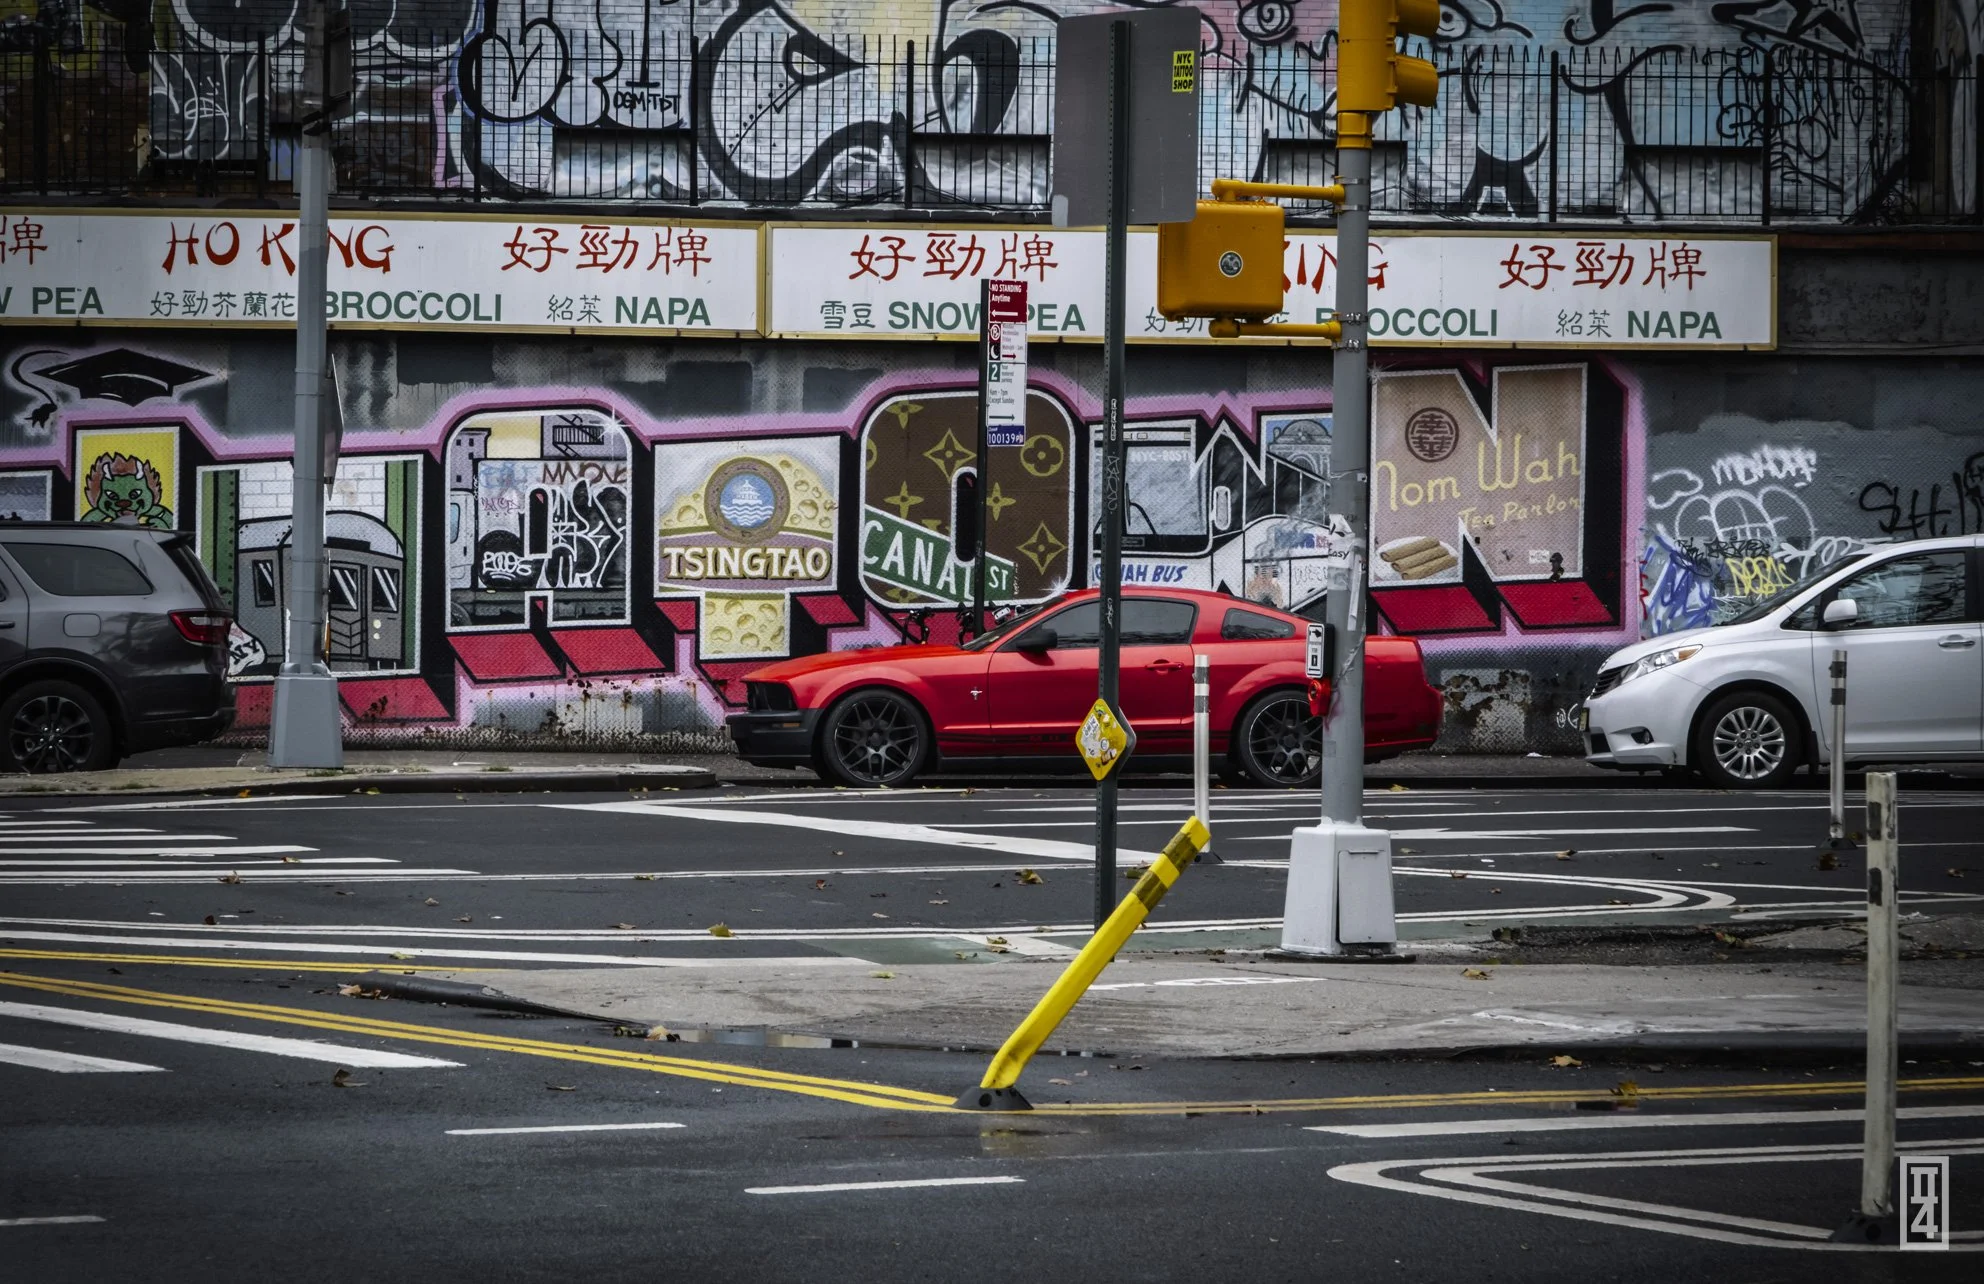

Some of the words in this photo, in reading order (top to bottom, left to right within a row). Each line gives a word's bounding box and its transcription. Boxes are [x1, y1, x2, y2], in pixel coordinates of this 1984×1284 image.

[1173, 65, 1194, 77] TATTOO
[1176, 53, 1192, 64] NYC
[1173, 79, 1193, 89] SHOP
[161, 221, 240, 275] HO
[256, 223, 395, 276] KNG
[501, 224, 712, 277] 好勁牌
[849, 232, 1059, 283] 好勁牌
[1498, 241, 1707, 291] 好勁牌
[32, 286, 105, 314] PEA
[991, 284, 999, 292] NO
[999, 284, 1022, 293] STANDING
[991, 294, 1011, 303] Anytime
[324, 290, 502, 323] BROCCOLI
[614, 295, 712, 327] NAPA
[820, 300, 876, 331] 雪豆
[1627, 310, 1723, 339] NAPA
[991, 363, 998, 381] 2
[988, 433, 1016, 445] 100139
[1478, 433, 1581, 491] Wah
[1458, 506, 1496, 528] Tea
[662, 546, 832, 581] TSINGTAO
[863, 519, 975, 601] CANAL
[988, 565, 1009, 591] ST
[1151, 564, 1188, 583] BUS
